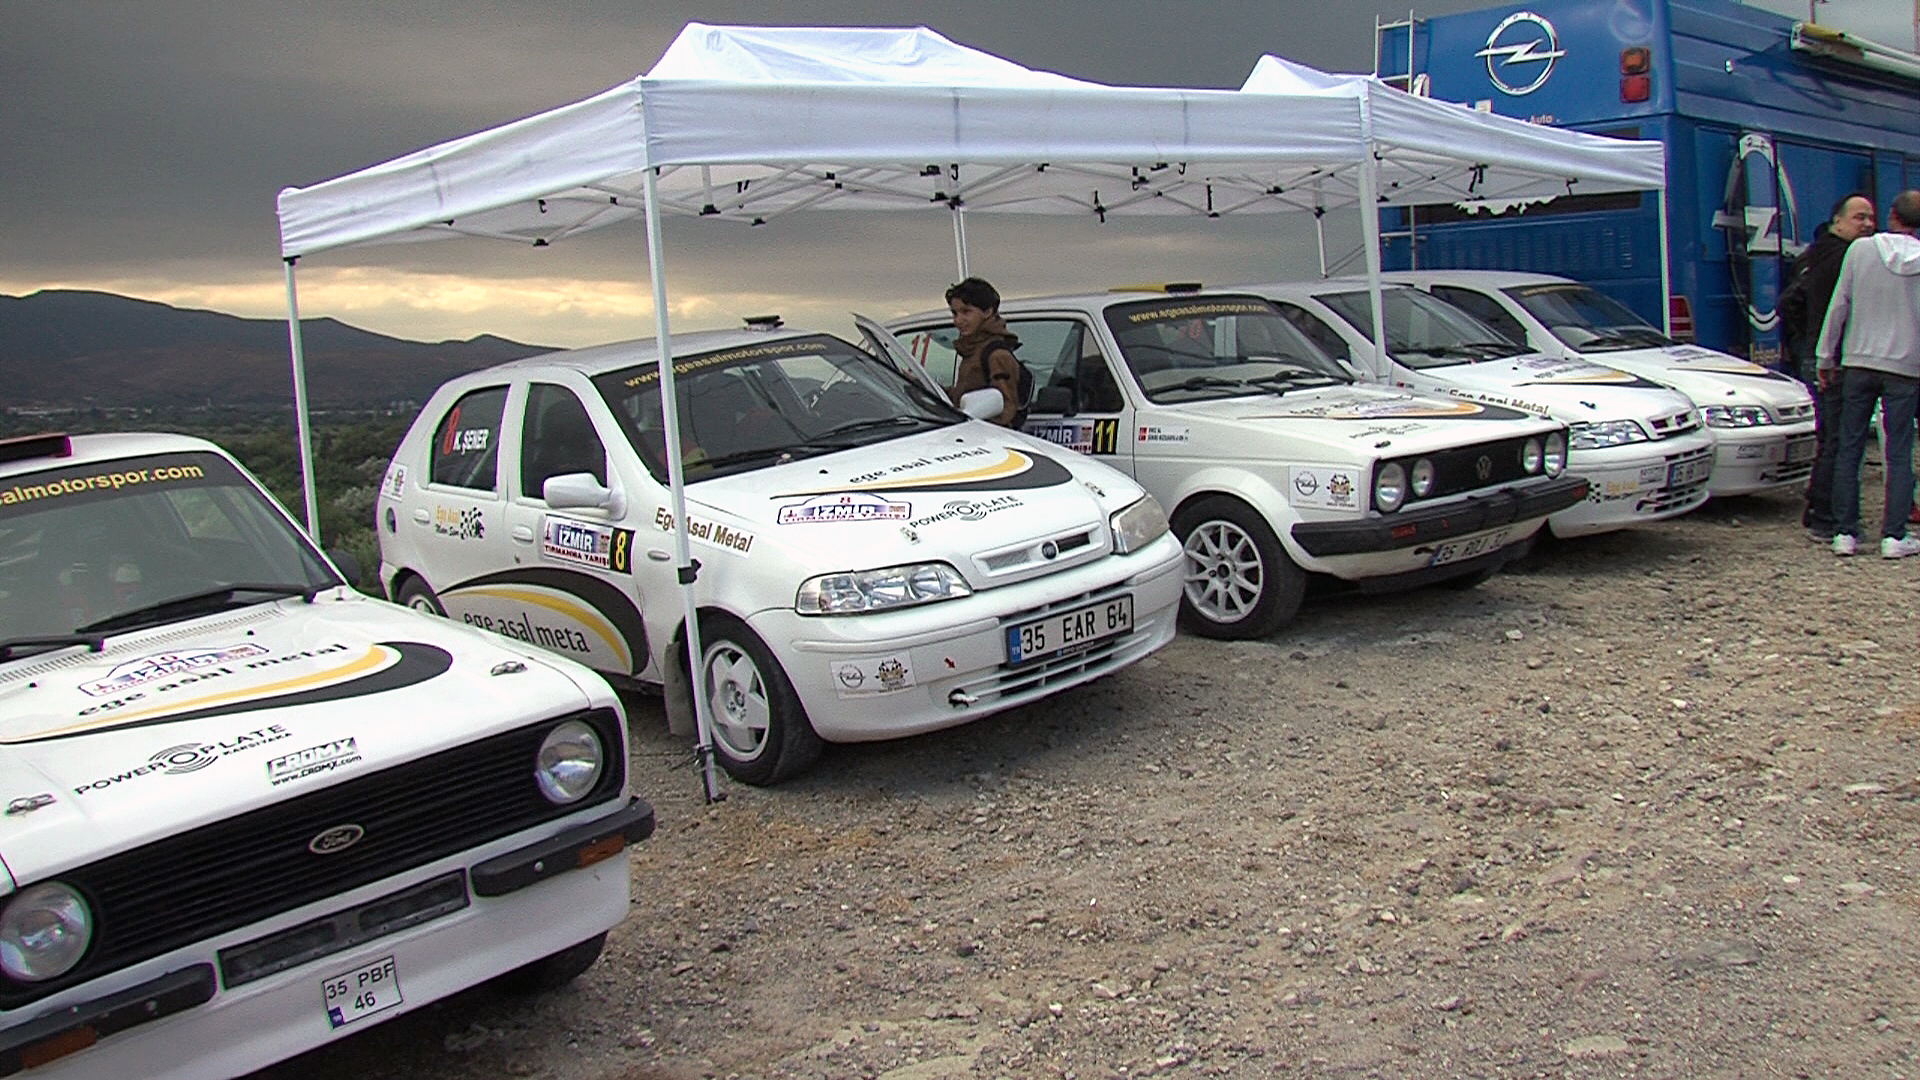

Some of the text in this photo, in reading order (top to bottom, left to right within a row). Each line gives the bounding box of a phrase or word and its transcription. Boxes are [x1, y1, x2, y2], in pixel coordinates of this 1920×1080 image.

[624, 342, 828, 387] wwwgeasalmotorspor.com
[1095, 420, 1115, 453] 11
[849, 446, 992, 485] ege asal metal
[909, 494, 1019, 529] POWER PLATE
[615, 530, 628, 571] 8
[713, 524, 754, 553] Metal
[497, 612, 536, 645] asal
[1022, 624, 1045, 654] 35
[1062, 610, 1096, 643] EAR
[1107, 602, 1127, 629] 64
[78, 692, 147, 717] ege
[157, 667, 235, 693] asal
[245, 643, 350, 669] metal
[74, 723, 288, 796] POWER PLATE
[267, 737, 356, 778] CROMX
[326, 961, 395, 1000] 35 PBF
[354, 991, 376, 1011] 46
